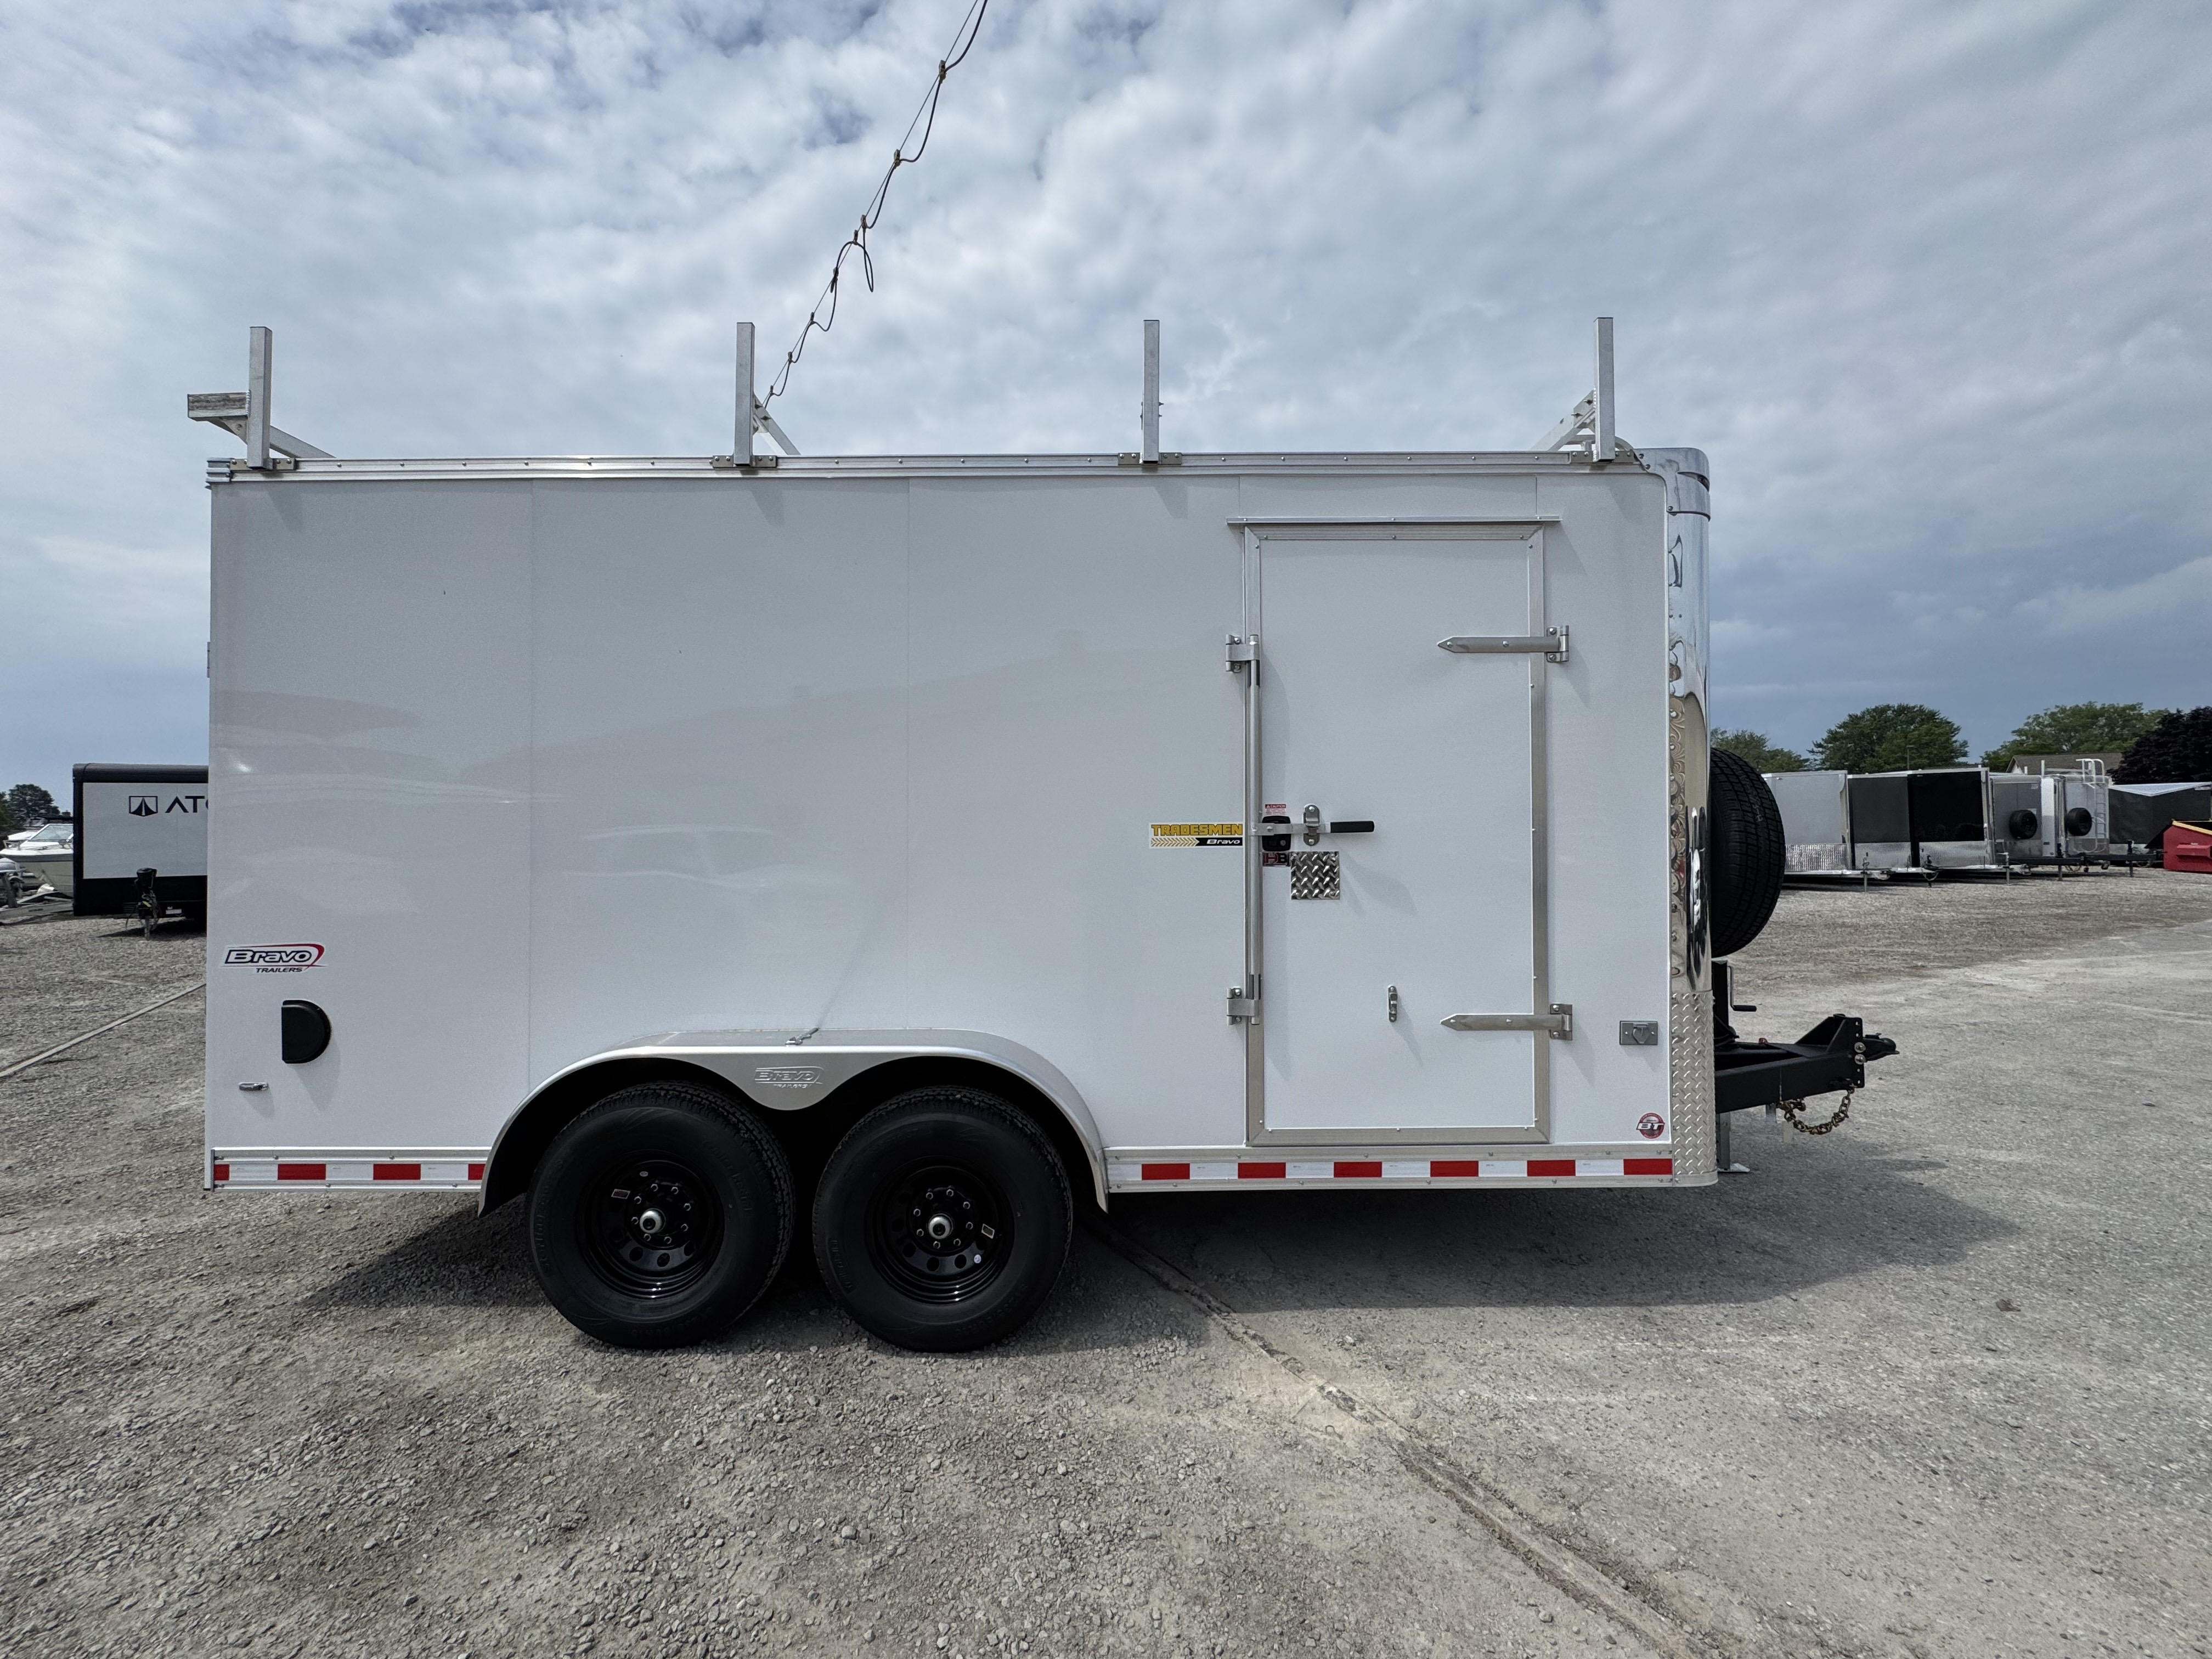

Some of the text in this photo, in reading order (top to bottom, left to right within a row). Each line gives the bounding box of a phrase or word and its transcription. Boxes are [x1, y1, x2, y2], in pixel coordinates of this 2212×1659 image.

[165, 795, 209, 814] AT
[1151, 823, 1243, 836] TRADESMEN
[225, 949, 312, 964] Bravo
[754, 1069, 816, 1081] Bravo
[1636, 1122, 1665, 1130] BT
